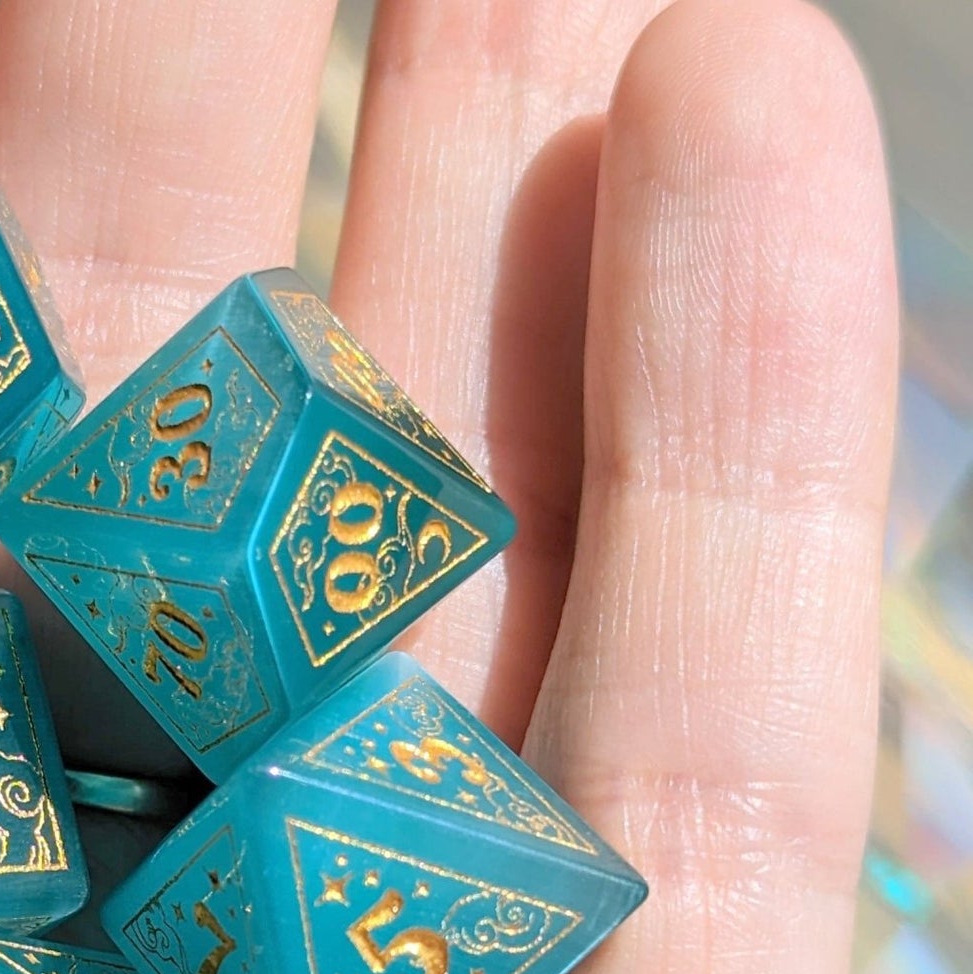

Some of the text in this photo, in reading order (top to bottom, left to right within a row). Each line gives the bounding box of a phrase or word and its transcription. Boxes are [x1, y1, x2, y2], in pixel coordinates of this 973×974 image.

[149, 383, 213, 502] 30
[325, 481, 384, 615] 00
[143, 600, 209, 700] 70
[389, 735, 490, 785] 3
